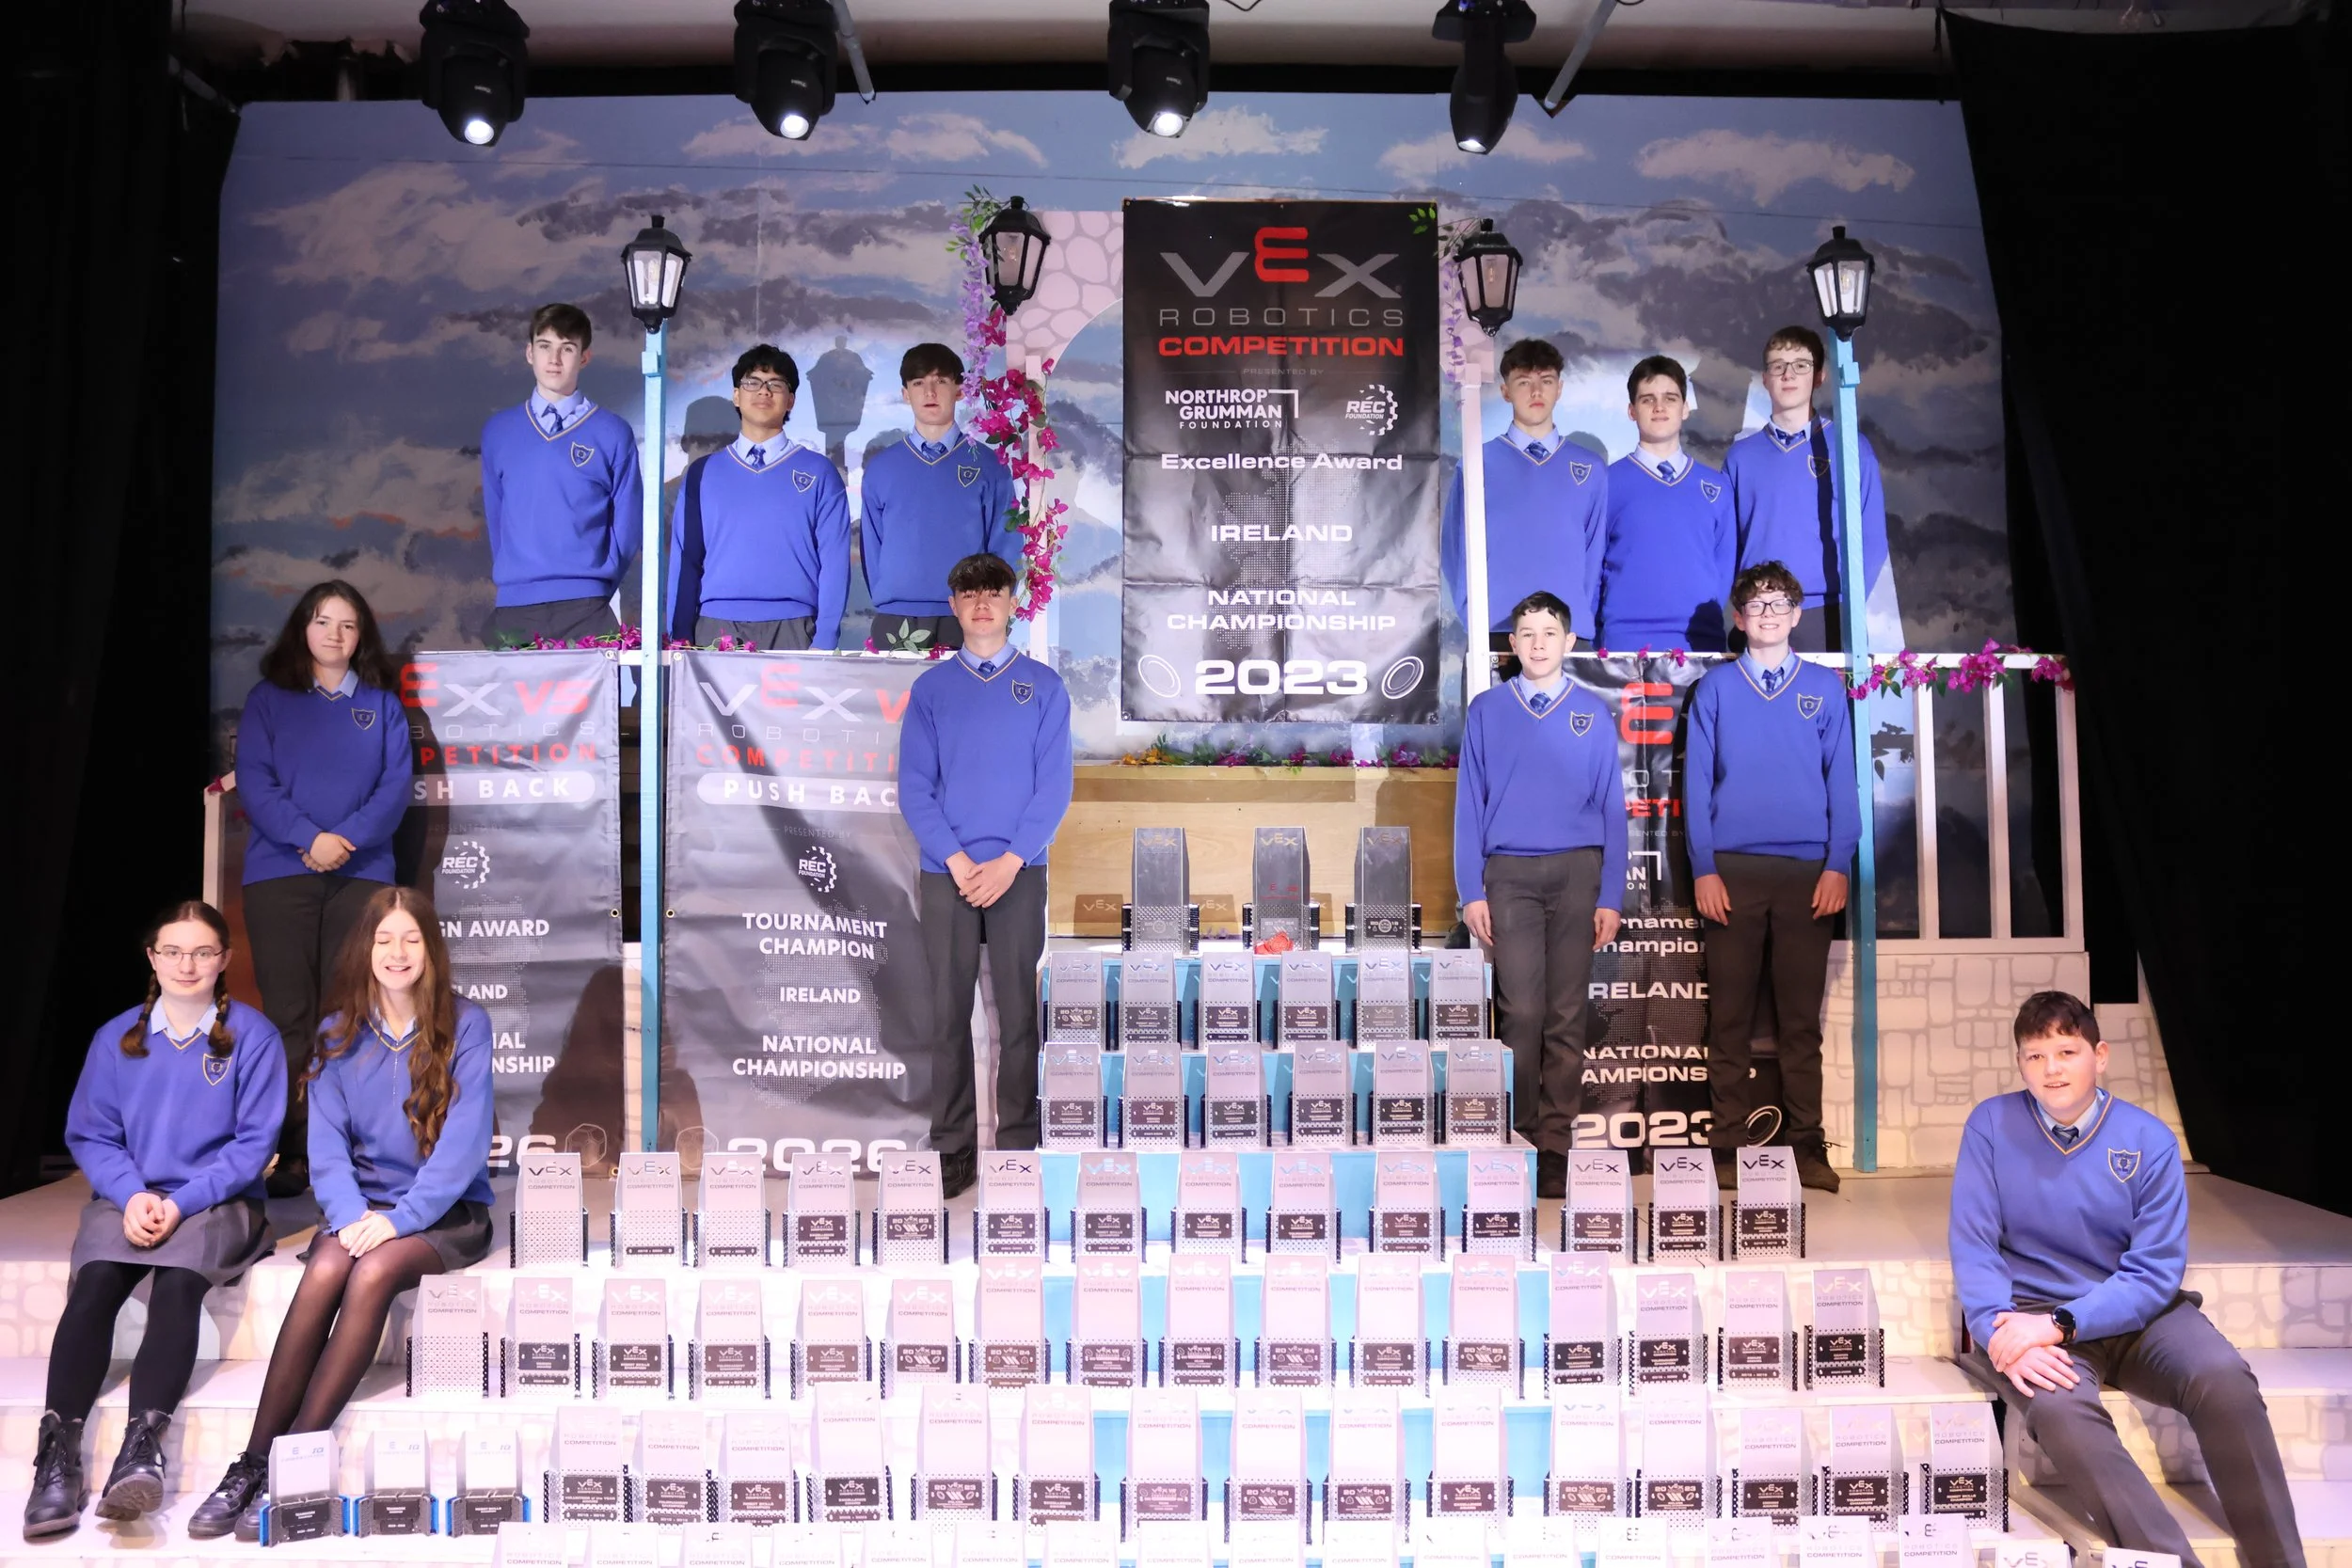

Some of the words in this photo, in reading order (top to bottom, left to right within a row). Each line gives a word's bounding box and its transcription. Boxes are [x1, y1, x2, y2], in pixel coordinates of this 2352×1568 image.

[1159, 227, 1402, 298] VEX
[1159, 308, 1404, 326] ROBOTICS
[1158, 337, 1404, 356] COMPETITION
[1166, 388, 1269, 404] NORTHROP
[1179, 404, 1282, 420] GRUMMAN
[1346, 401, 1386, 414] REC
[1179, 420, 1282, 429] FOUNDATION
[1161, 453, 1306, 470] Excellence
[1312, 453, 1403, 470] Award
[1211, 525, 1353, 542] IRELAND
[1208, 590, 1357, 606] NATIONAL
[1167, 613, 1396, 631] CHAMPIONSHIP
[1195, 659, 1368, 695] 2023
[400, 662, 503, 717] EX
[514, 680, 597, 715] V5
[699, 662, 863, 722] VEX
[409, 721, 596, 739] BOTICS
[698, 723, 879, 745] ROBOTI
[421, 743, 596, 766] PETITION
[696, 744, 894, 772] COMPETITI
[414, 781, 453, 800] SH
[479, 778, 570, 799] BACK
[723, 779, 805, 803] PUSH
[830, 786, 898, 807] BAC
[469, 919, 549, 937] AWARD
[742, 912, 887, 939] TOURNAMENT
[759, 938, 875, 960] CHAMPION
[780, 987, 861, 1004] IRELAND
[1588, 982, 1709, 1000] RELAND
[762, 1035, 877, 1054] NATIONAL
[732, 1058, 907, 1080] CHAMPIONSHIP
[1465, 1099, 1486, 1107] VEX
[888, 1160, 931, 1175] VEX
[989, 1159, 1032, 1174] VEX
[1384, 1159, 1427, 1174] VEX
[1474, 1158, 1518, 1174] VEX
[1575, 1158, 1619, 1173] VEX
[1661, 1157, 1704, 1172] VEX
[1742, 1154, 1786, 1169] VEX
[1586, 1215, 1610, 1224] VEX
[1673, 1213, 1694, 1222] VEX
[1755, 1211, 1776, 1219] VEX
[1654, 1341, 1677, 1351] VEX
[1742, 1339, 1765, 1348] VEX
[1830, 1337, 1852, 1345] VEX
[532, 1346, 556, 1354] VEX
[624, 1346, 647, 1354] VEX
[719, 1348, 742, 1356] VEX
[1568, 1345, 1591, 1354] VEX
[578, 1479, 602, 1488] VEX
[660, 1483, 686, 1492] VEX
[745, 1483, 771, 1493] VEX
[839, 1481, 864, 1490] VEX
[1759, 1483, 1783, 1493] VEX
[1850, 1481, 1873, 1489] VEX
[1949, 1477, 1974, 1485] VEX
